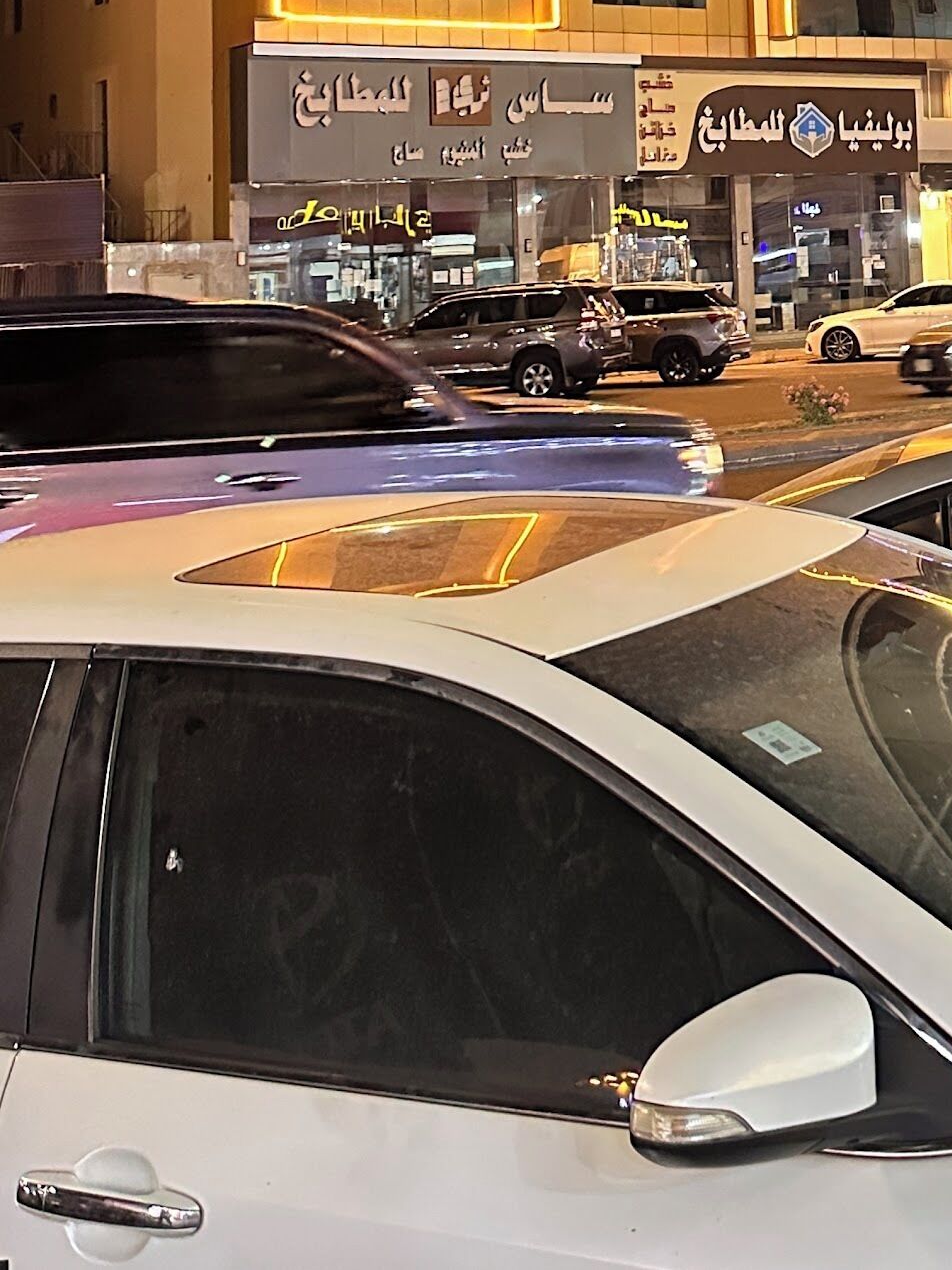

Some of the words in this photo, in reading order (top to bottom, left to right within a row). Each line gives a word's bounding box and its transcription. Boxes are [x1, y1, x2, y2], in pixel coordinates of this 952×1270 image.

[292, 69, 413, 128] للمطابخ
[504, 77, 614, 124] ساس
[639, 72, 674, 93] خشب
[502, 136, 533, 166] خشب
[697, 105, 785, 154] للمطابخ
[837, 108, 913, 152] بوليفيا
